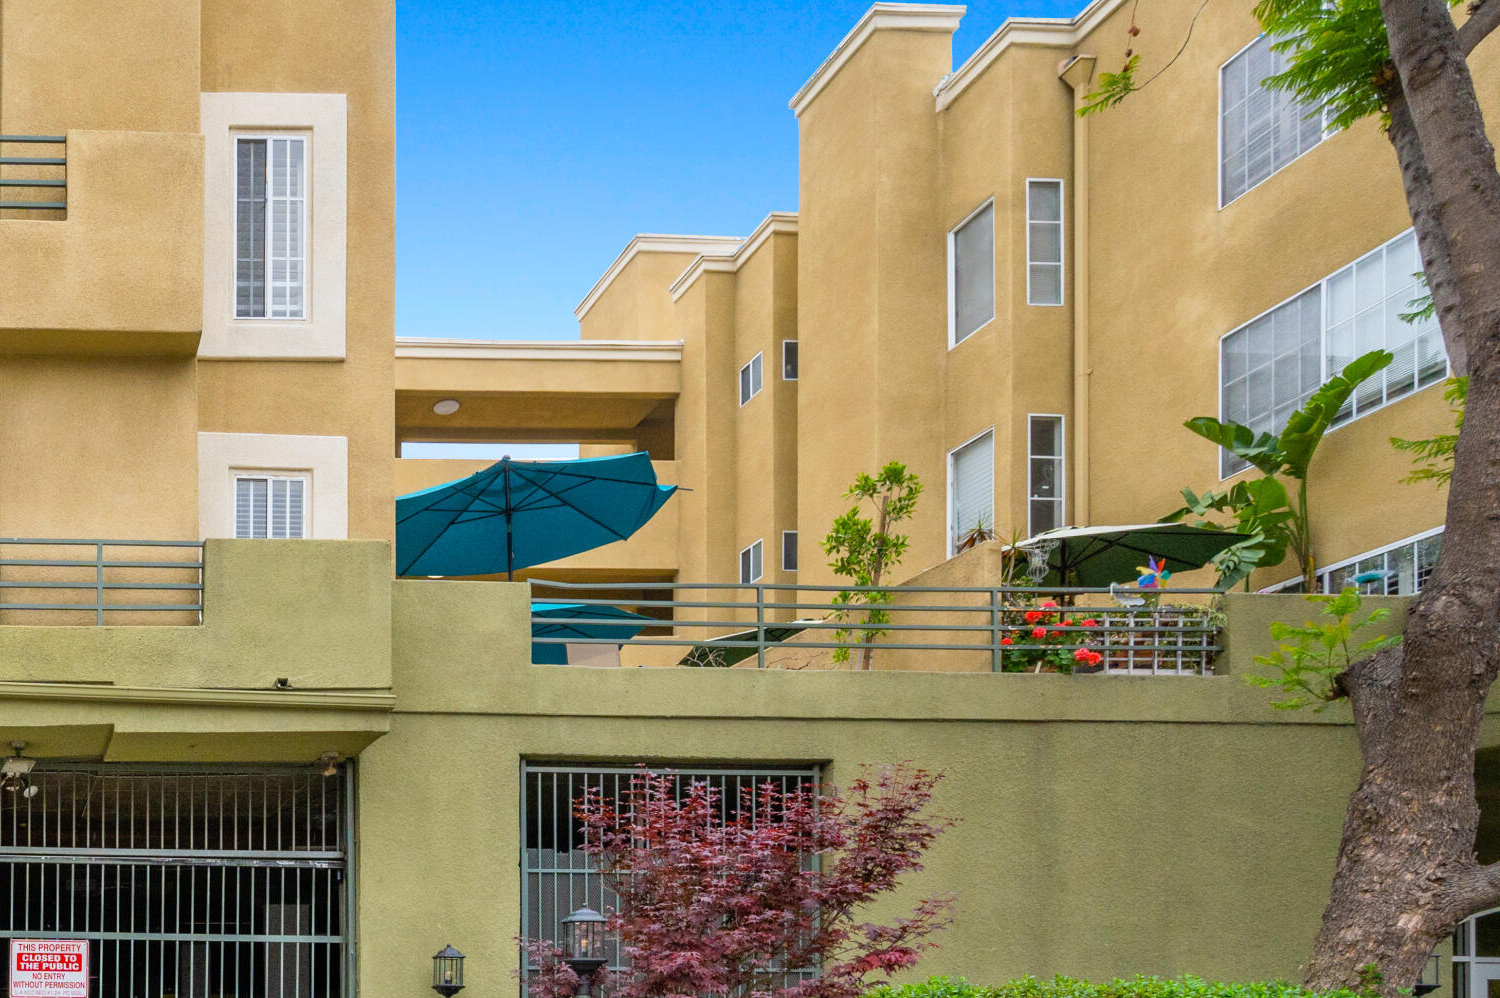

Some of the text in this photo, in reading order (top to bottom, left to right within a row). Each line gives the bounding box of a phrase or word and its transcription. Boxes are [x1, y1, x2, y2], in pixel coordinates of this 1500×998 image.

[18, 943, 82, 952] THIS PROPERTY
[21, 954, 77, 962] CLOSED TO
[20, 962, 80, 971] THE PUBLIC
[32, 972, 66, 980] NO ENTRY
[12, 981, 85, 989] WITHOUT PERMISSION
